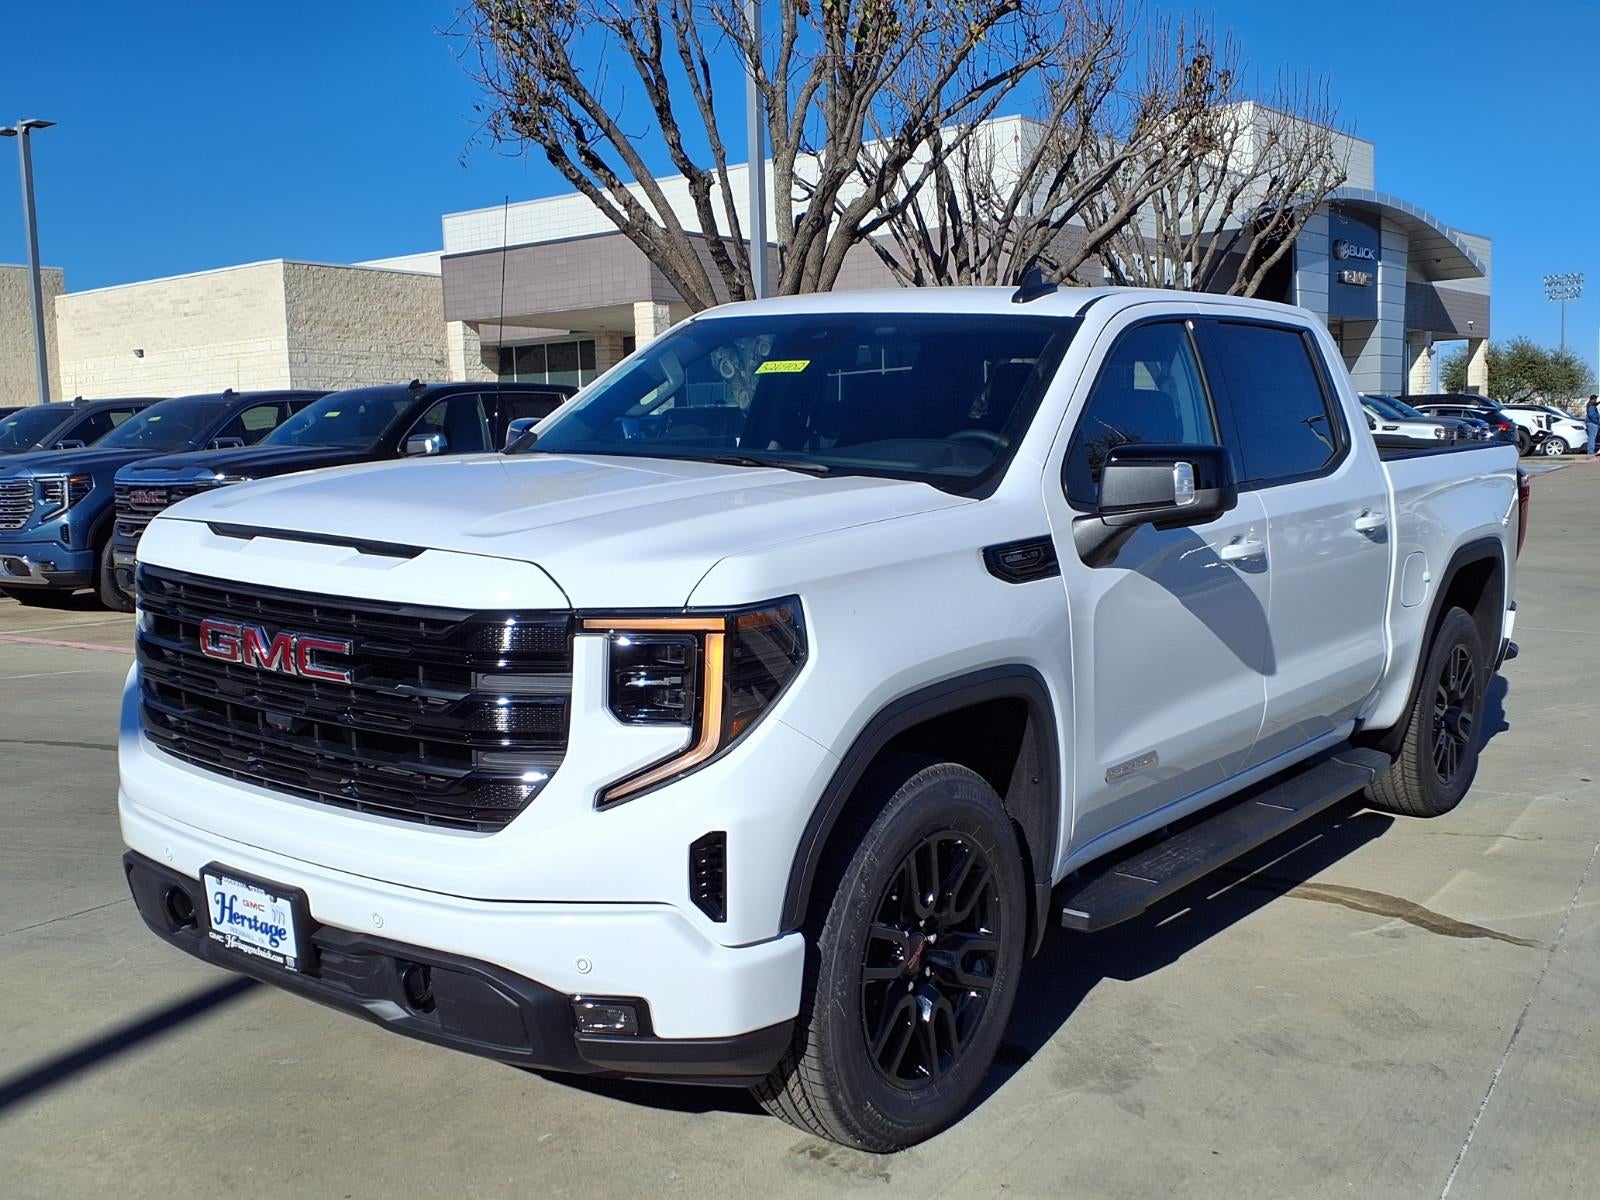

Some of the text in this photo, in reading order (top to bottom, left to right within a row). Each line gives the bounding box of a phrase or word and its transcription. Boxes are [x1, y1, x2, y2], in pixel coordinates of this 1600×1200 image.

[1349, 245, 1375, 260] BUICK
[129, 491, 167, 503] GMC
[200, 617, 353, 684] GMC
[242, 899, 265, 912] GMC
[214, 891, 287, 948] Heritage
